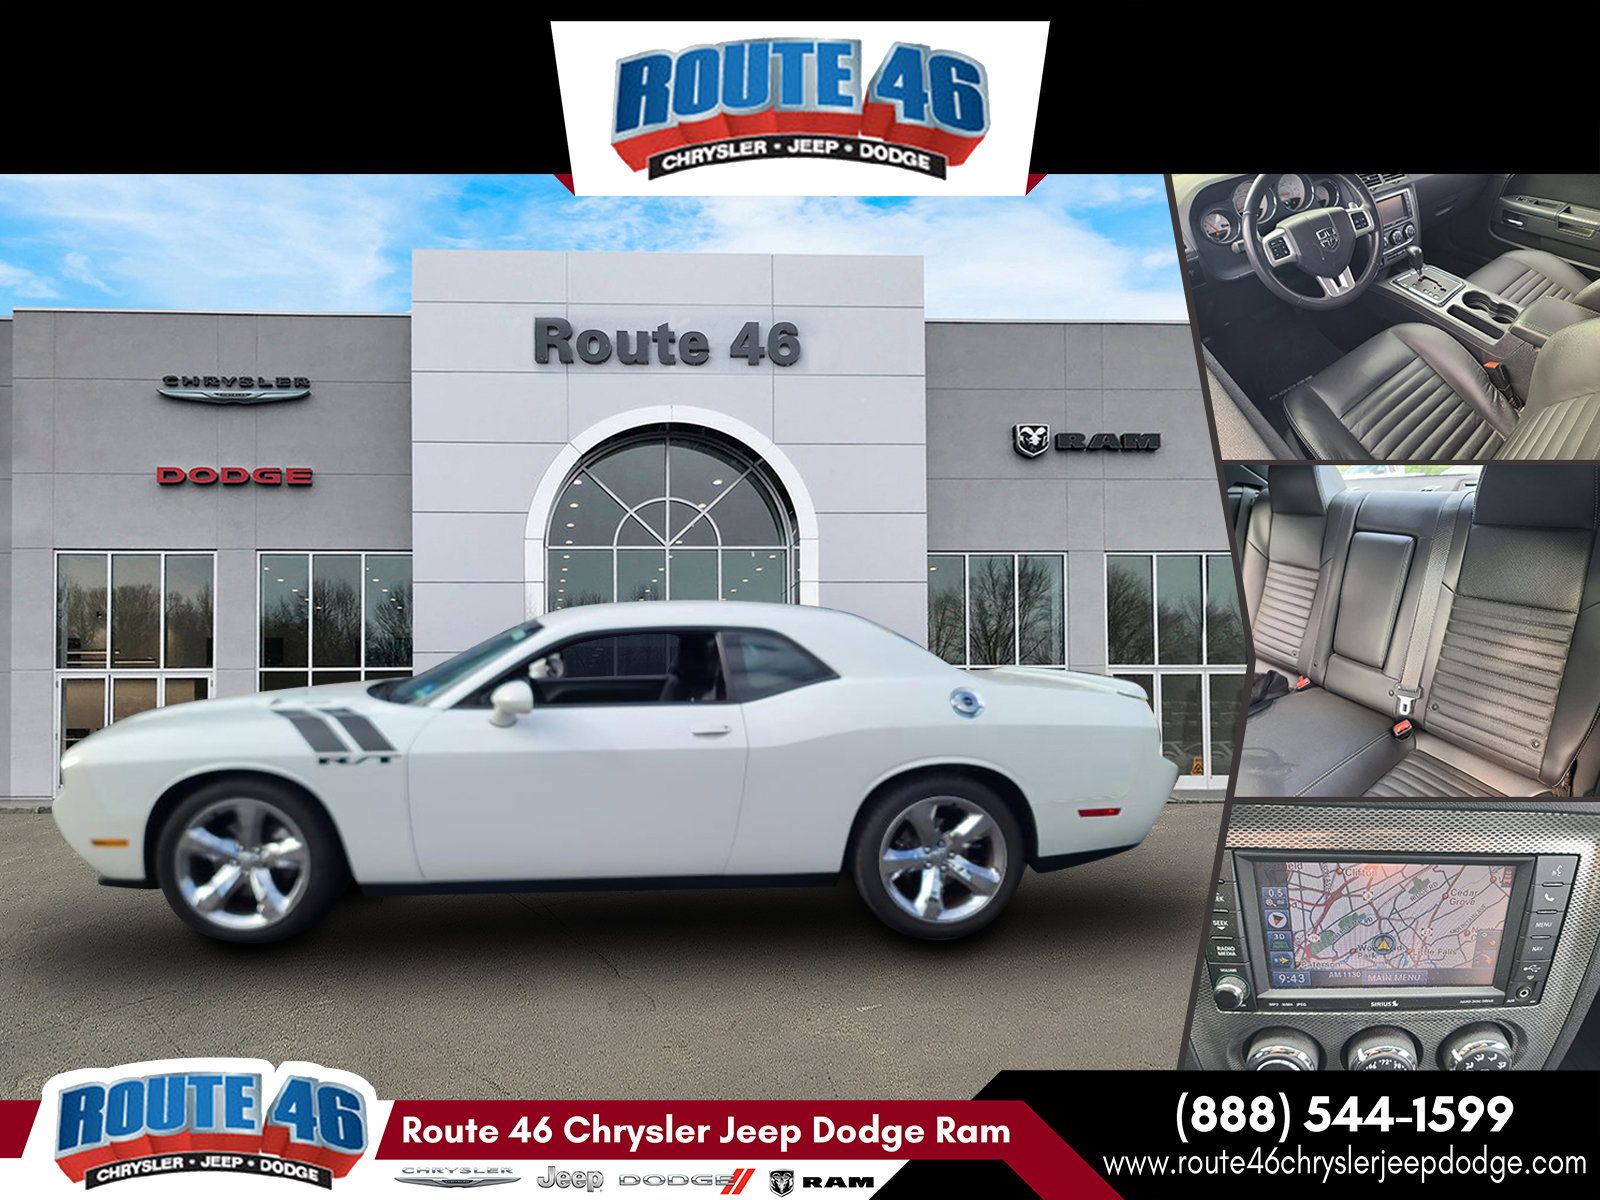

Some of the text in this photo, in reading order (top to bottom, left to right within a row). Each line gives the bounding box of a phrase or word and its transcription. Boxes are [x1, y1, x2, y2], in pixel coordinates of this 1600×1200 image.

[534, 317, 801, 366] Route 46
[162, 375, 311, 389] CHRYSLER
[1055, 432, 1161, 451] RAM
[157, 466, 313, 486] DODGE
[1345, 867, 1377, 877] Clifton
[1268, 888, 1283, 898] 0.5
[1450, 889, 1478, 897] Cedar
[1450, 898, 1475, 906] Grove
[1278, 973, 1305, 984] 9:43
[1394, 974, 1421, 982] MENU
